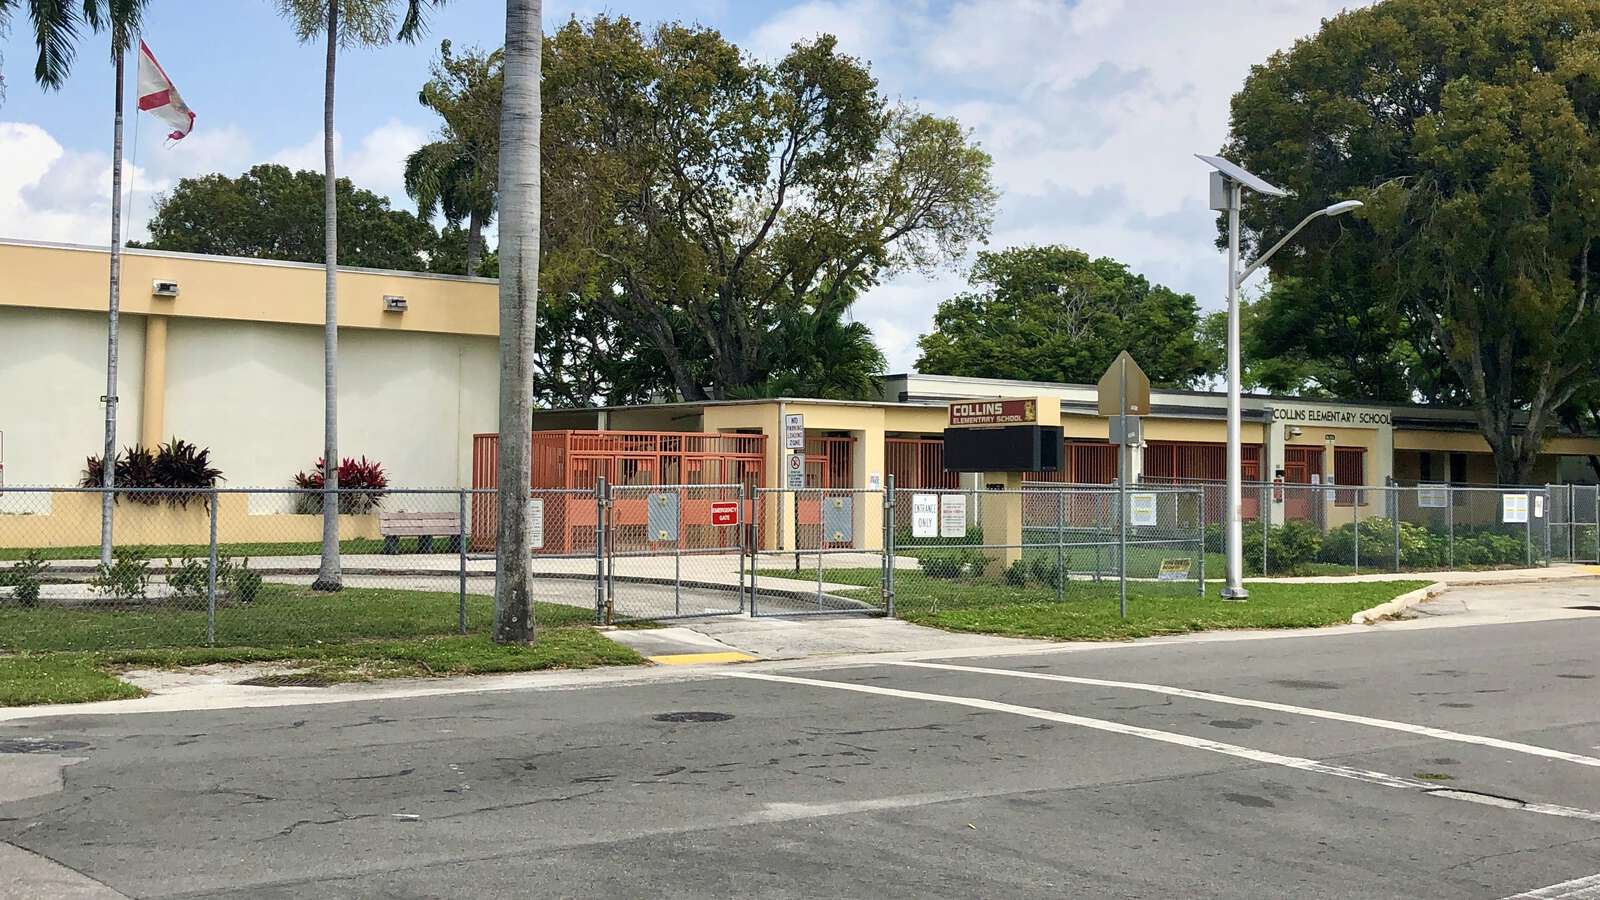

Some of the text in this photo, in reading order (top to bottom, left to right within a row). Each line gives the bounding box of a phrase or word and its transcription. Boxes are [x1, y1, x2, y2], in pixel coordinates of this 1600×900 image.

[953, 403, 1003, 416] COLLINS
[953, 415, 1023, 424] ELEMENTARY SCHOOL
[1274, 409, 1391, 425] COLLINS ELEMENTARY SCHOOL
[914, 503, 936, 513] ENTRANCE
[918, 517, 932, 528] ONLY
